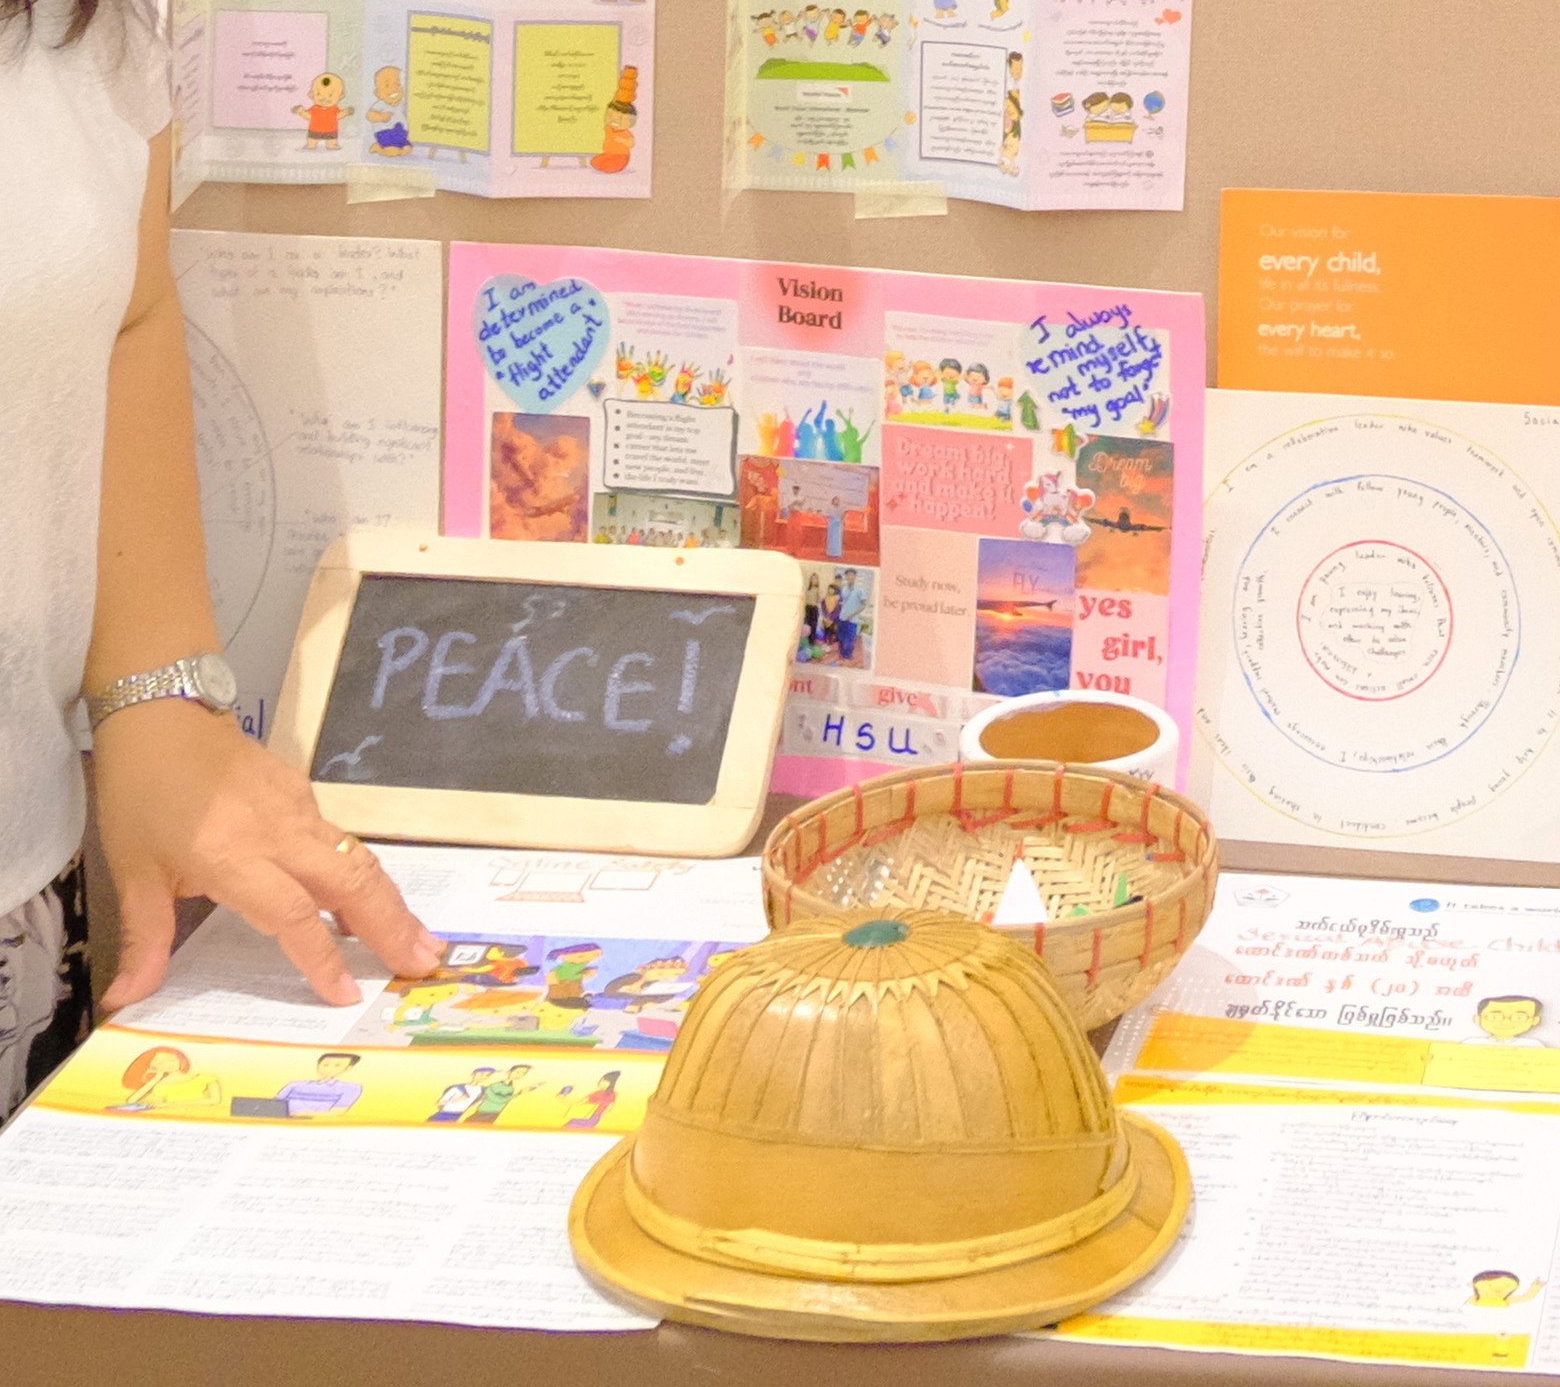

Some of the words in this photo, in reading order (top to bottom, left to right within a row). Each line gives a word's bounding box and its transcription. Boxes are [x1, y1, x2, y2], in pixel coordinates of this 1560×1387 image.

[1258, 254, 1320, 278] every
[1326, 250, 1382, 276] child,
[776, 278, 844, 304] Vision
[777, 305, 843, 331] Board
[1257, 323, 1306, 343] every
[1310, 320, 1362, 341] heart,
[1078, 594, 1132, 622] yes
[1101, 632, 1164, 665] girl,
[370, 626, 701, 756] PEACE!
[877, 684, 918, 707] give
[822, 714, 918, 757] HSU
